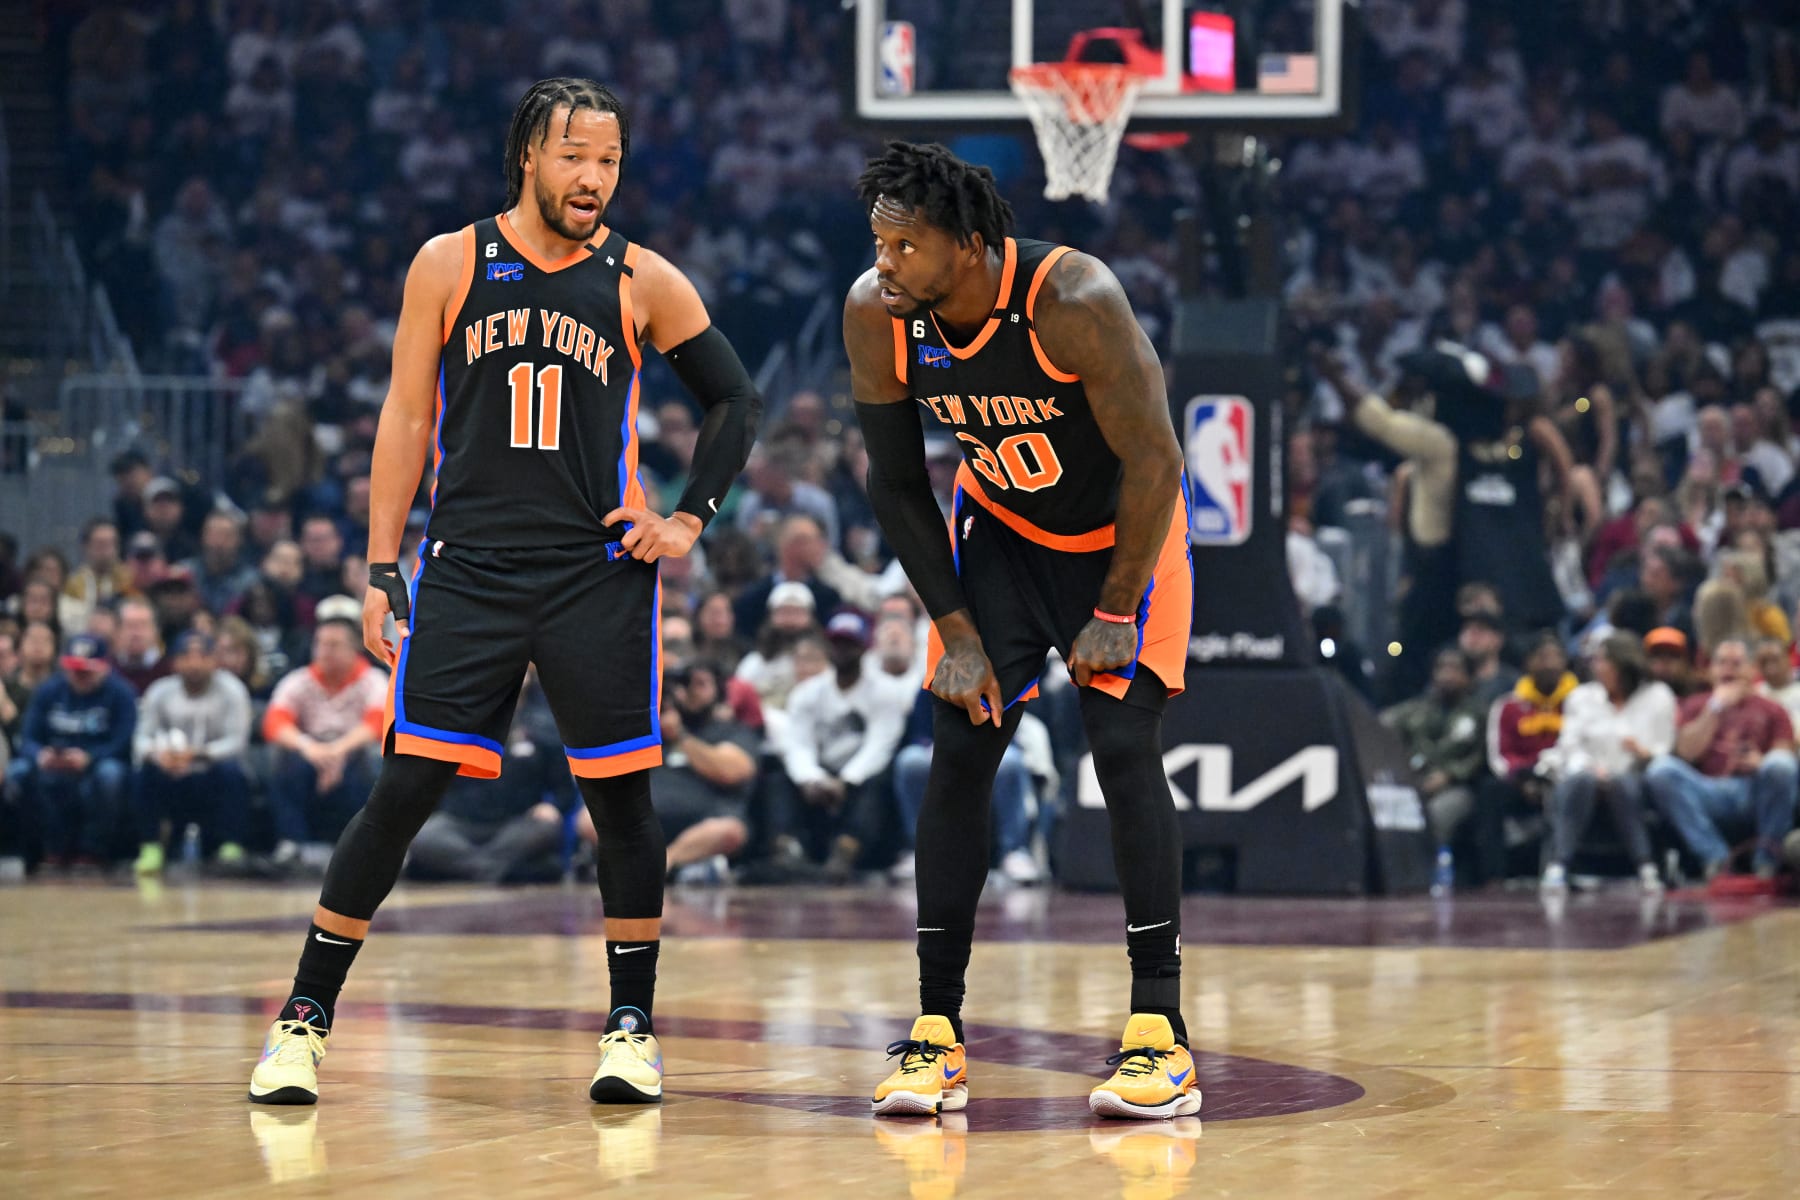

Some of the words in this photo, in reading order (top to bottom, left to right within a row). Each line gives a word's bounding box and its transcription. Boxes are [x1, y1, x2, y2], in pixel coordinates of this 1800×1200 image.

[485, 242, 498, 258] 6
[486, 262, 524, 281] NYC
[912, 319, 925, 338] 6
[1010, 312, 1020, 323] 19
[465, 307, 531, 366] NEW
[539, 308, 615, 386] YORK
[917, 344, 951, 369] NYC
[507, 361, 563, 450] 11
[916, 394, 967, 424] EW
[968, 395, 1065, 426] YORK
[955, 431, 1064, 493] 30
